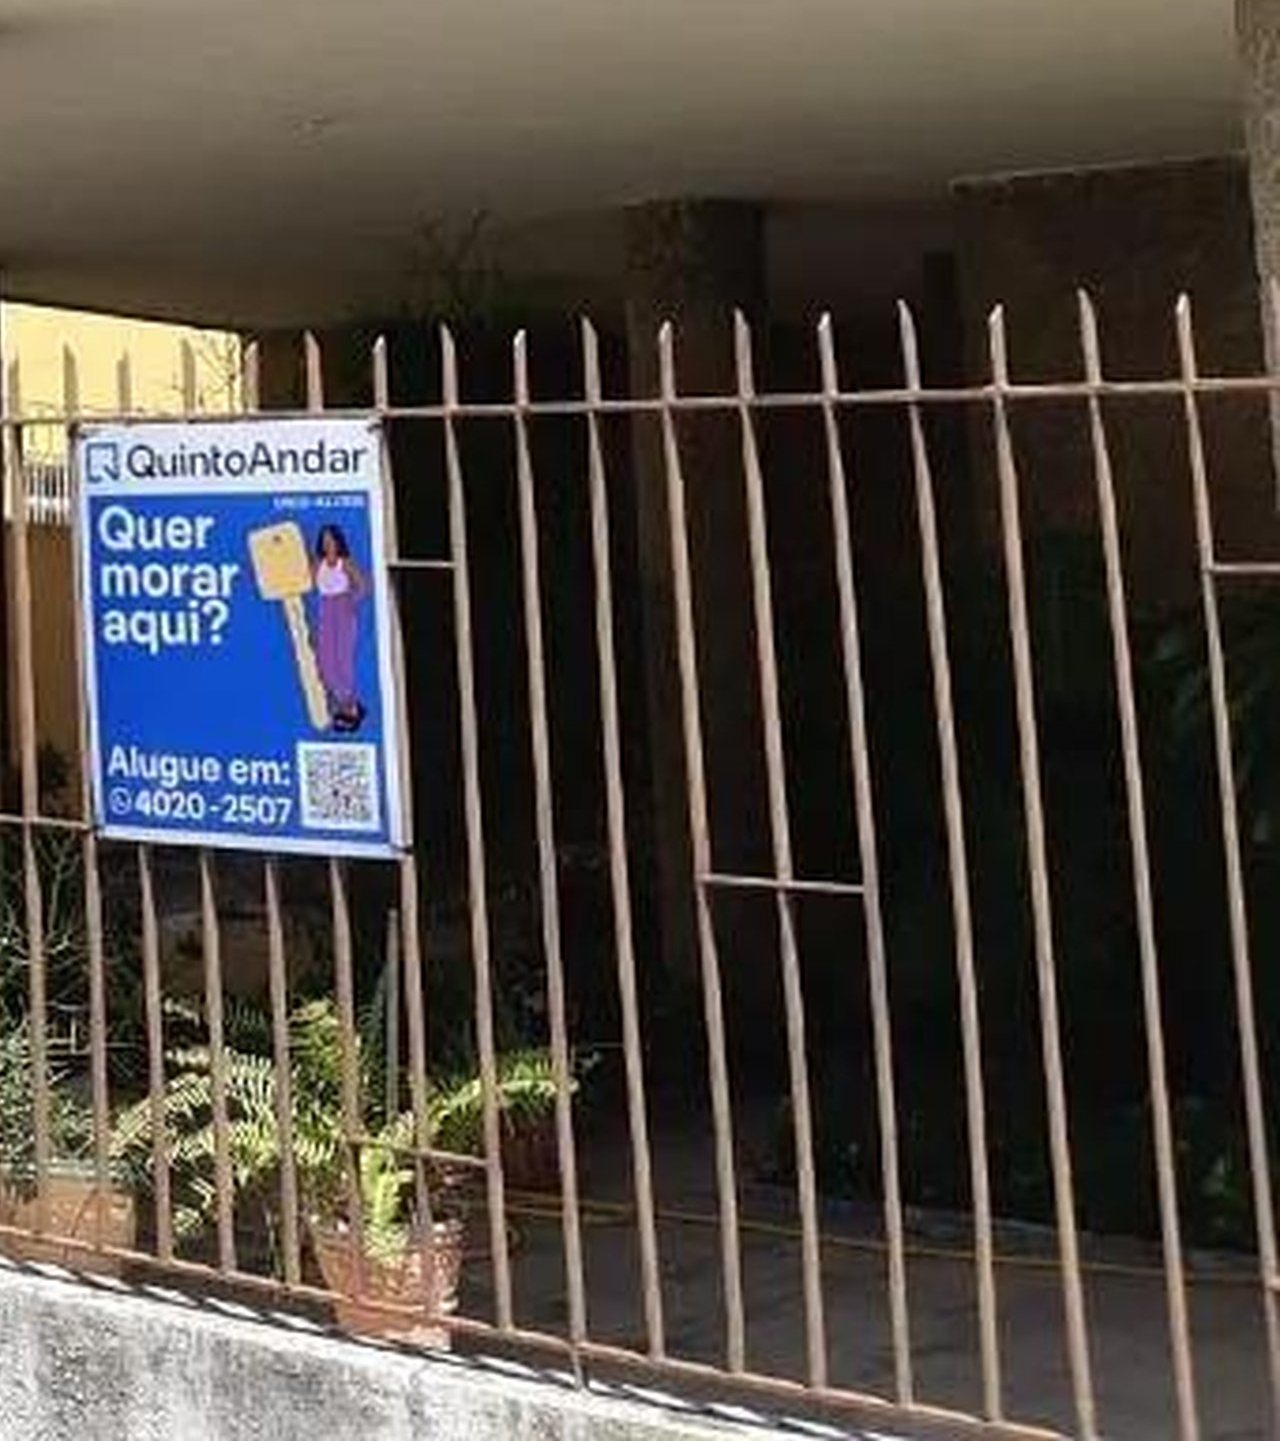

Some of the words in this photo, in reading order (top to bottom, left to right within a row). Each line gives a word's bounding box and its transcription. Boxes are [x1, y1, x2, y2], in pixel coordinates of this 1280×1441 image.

[127, 440, 366, 478] QuintoAndar
[99, 505, 214, 551] Quer
[101, 562, 239, 597] morar
[103, 600, 229, 654] aqui?
[107, 745, 220, 788] Alugue
[229, 759, 290, 786] em:
